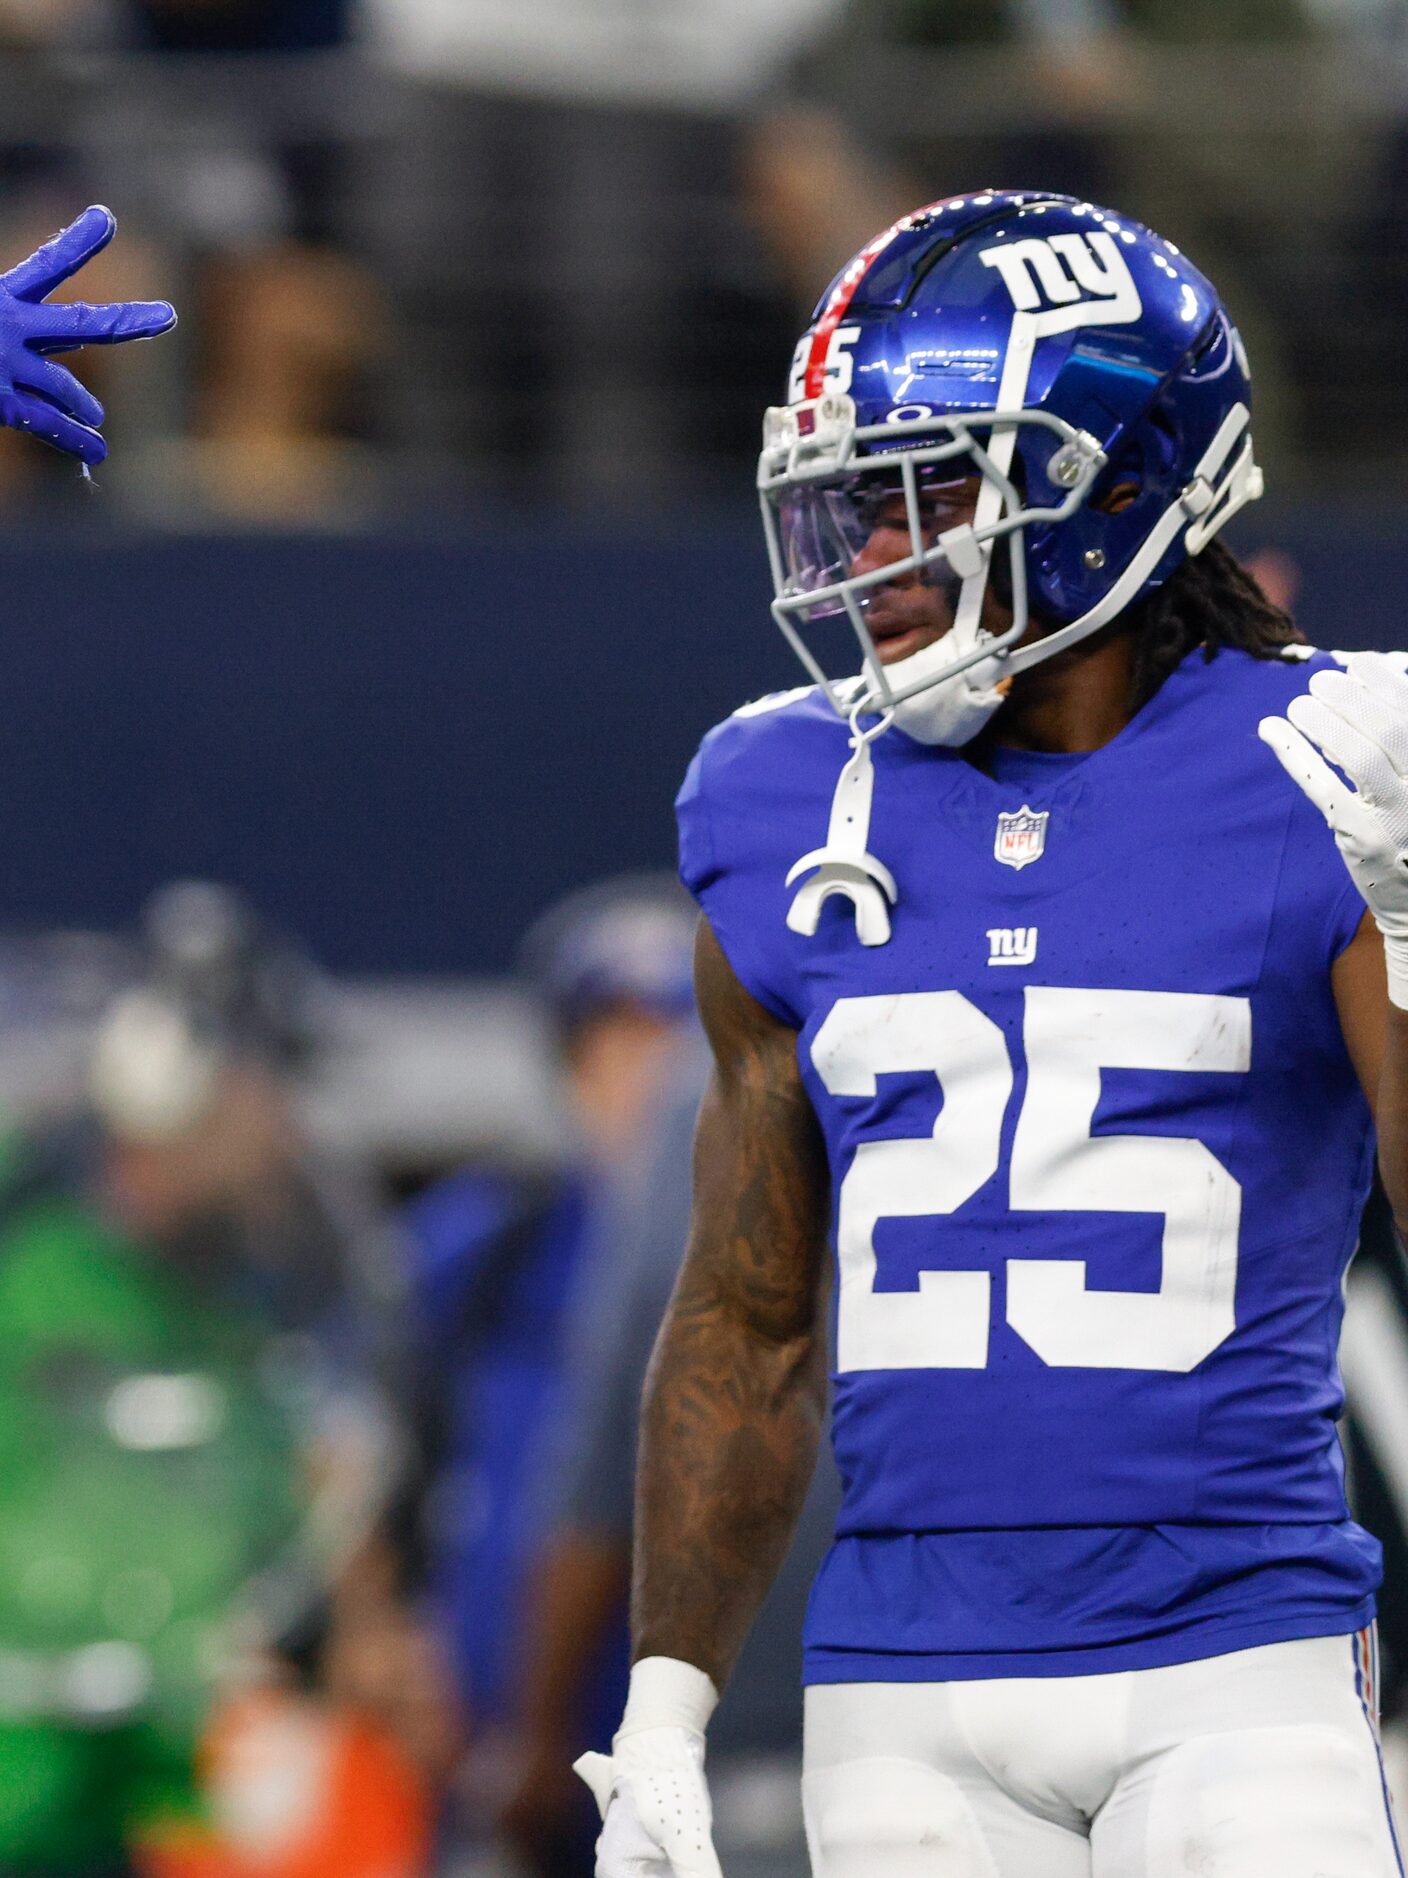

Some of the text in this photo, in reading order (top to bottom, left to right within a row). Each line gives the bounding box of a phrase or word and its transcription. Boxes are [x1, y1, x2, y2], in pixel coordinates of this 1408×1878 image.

[1004, 831, 1038, 851] NFL
[986, 927, 1038, 966] ny
[811, 986, 1252, 1373] 25
